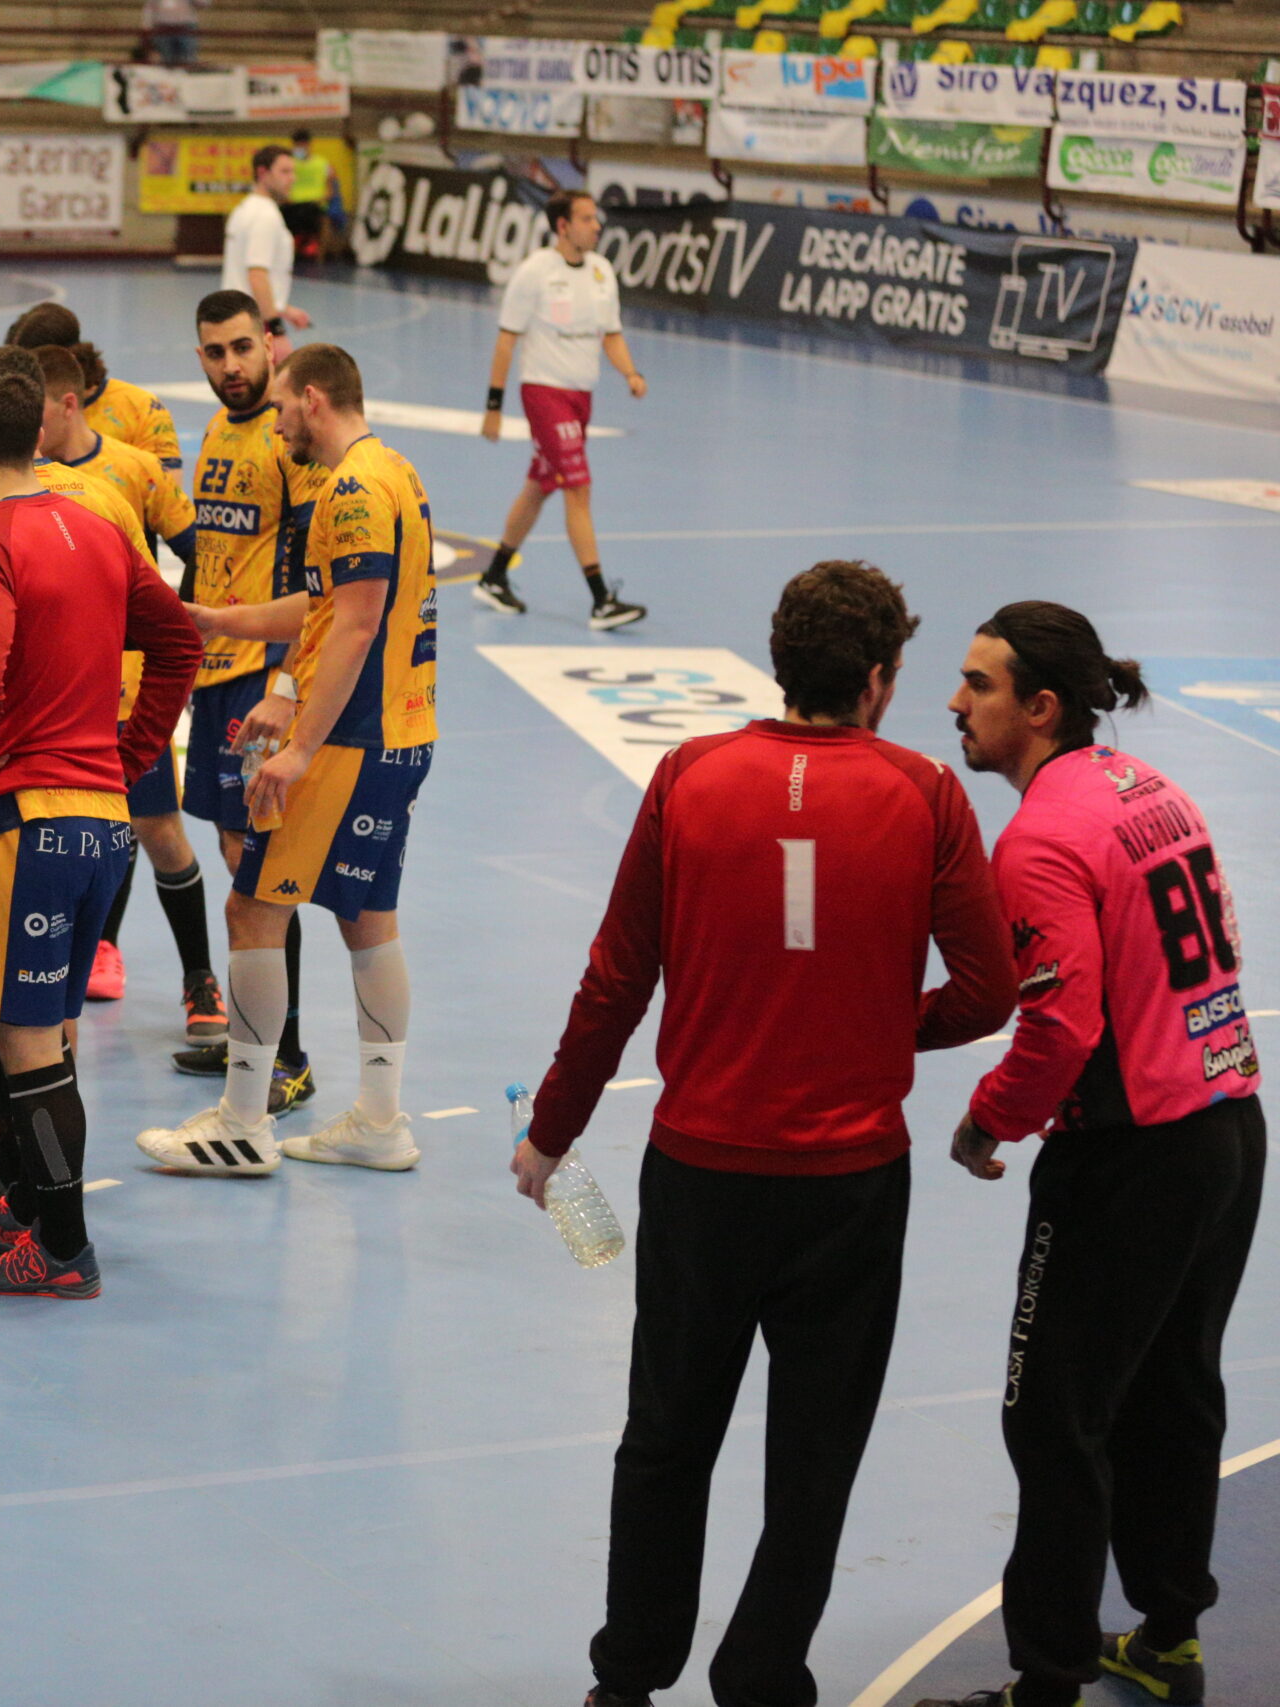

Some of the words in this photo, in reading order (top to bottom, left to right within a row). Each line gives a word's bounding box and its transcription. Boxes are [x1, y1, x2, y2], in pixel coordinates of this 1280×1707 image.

[586, 46, 640, 81] OTIS
[655, 47, 713, 85] OTIS
[781, 53, 864, 95] lupa
[1176, 76, 1240, 116] S.L.
[404, 175, 558, 287] LaLiga
[592, 212, 775, 299] portsTV
[798, 224, 968, 288] DESCÁRGATE
[780, 272, 813, 313] LA
[816, 281, 870, 322] APP
[871, 284, 969, 337] GRATIS
[1035, 260, 1086, 323] TV
[200, 458, 234, 495] 23
[788, 753, 808, 812] Kappa
[36, 827, 69, 855] EL
[776, 838, 816, 950] 1
[1012, 1221, 1054, 1342] FLORENCIO
[1004, 1350, 1025, 1407] CASA
